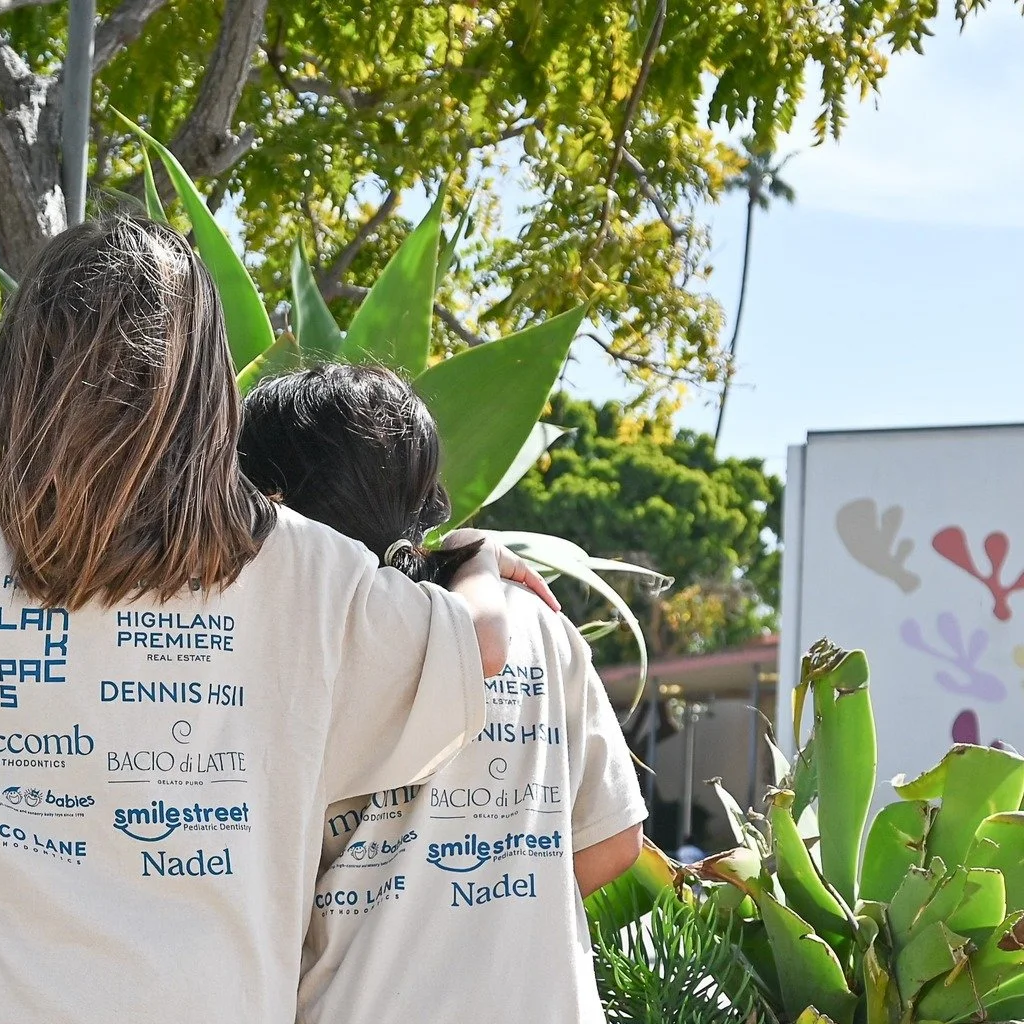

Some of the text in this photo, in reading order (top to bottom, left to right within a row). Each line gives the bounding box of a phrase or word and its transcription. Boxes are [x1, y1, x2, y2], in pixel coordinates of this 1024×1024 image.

[117, 611, 235, 632] HIGHLAND
[117, 631, 234, 652] PREMIERE
[146, 653, 211, 663] REAL ESTATE
[101, 680, 244, 707] DENNIS HSII
[107, 751, 246, 773] BACIO di LATTE
[185, 779, 204, 787] PURO
[45, 789, 96, 808] babies
[430, 787, 491, 808] BACIO
[495, 789, 508, 807] di
[500, 810, 519, 819] PURO
[183, 823, 252, 833] Pediatric Dentistry
[33, 833, 87, 857] LANE
[493, 848, 564, 862] Pediatric Dentistry
[141, 848, 234, 877] Nadel
[315, 875, 406, 909] COCO LANE
[451, 872, 537, 907] Nadel
